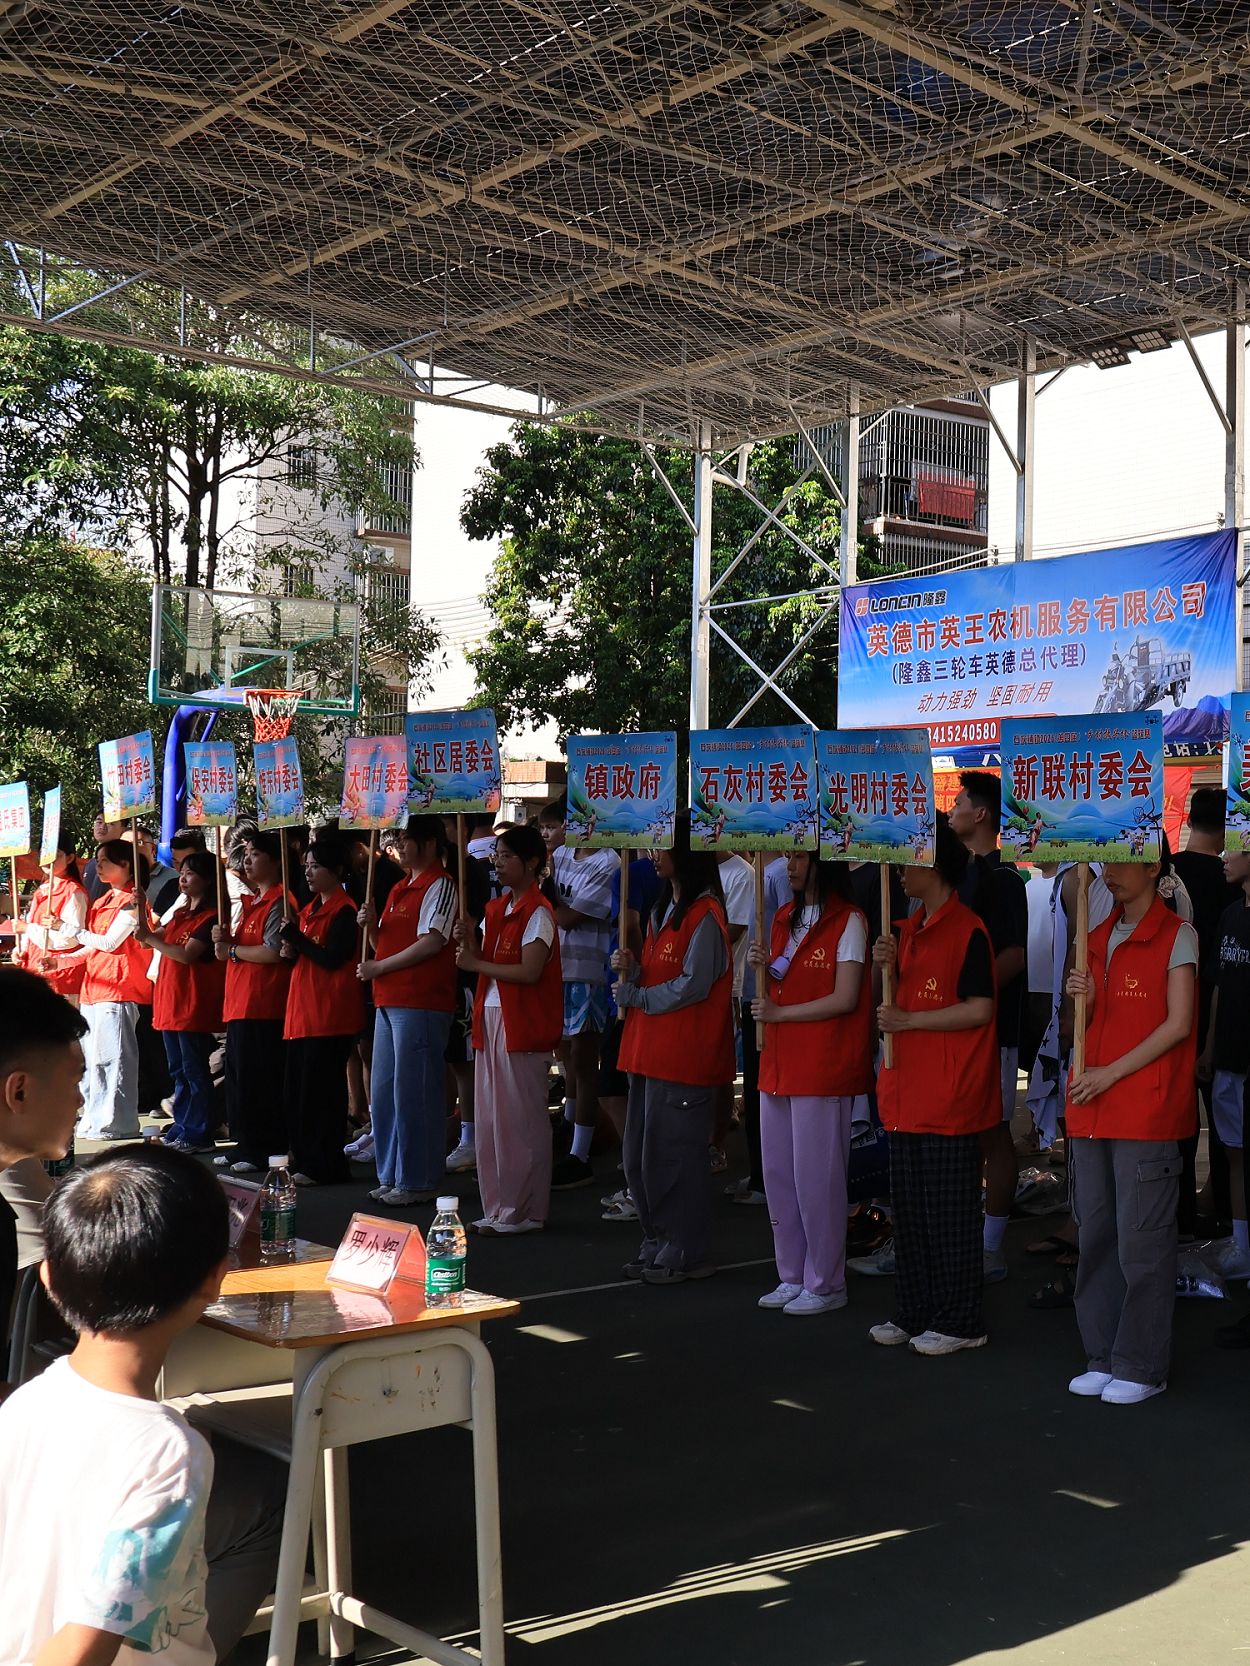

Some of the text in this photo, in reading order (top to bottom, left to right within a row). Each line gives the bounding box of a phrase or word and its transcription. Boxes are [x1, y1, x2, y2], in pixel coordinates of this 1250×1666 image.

[923, 589, 947, 606] 隆鑫
[866, 581, 1207, 657] 英德市英王农机服务有限公司
[917, 681, 1052, 714] 动力强劲 坚固耐用
[107, 755, 151, 790] 竹田村委会
[414, 738, 494, 775] 社区居委会
[1013, 749, 1152, 801] 新联村委会
[191, 765, 234, 794] 保安村委会
[348, 762, 408, 793] 大田村委会
[584, 761, 662, 800] 镇政府
[700, 761, 808, 803] 石灰村委会
[828, 771, 927, 816] 光明村委会
[0, 806, 25, 831] 氏集团
[341, 1230, 400, 1272] 罗少辉
